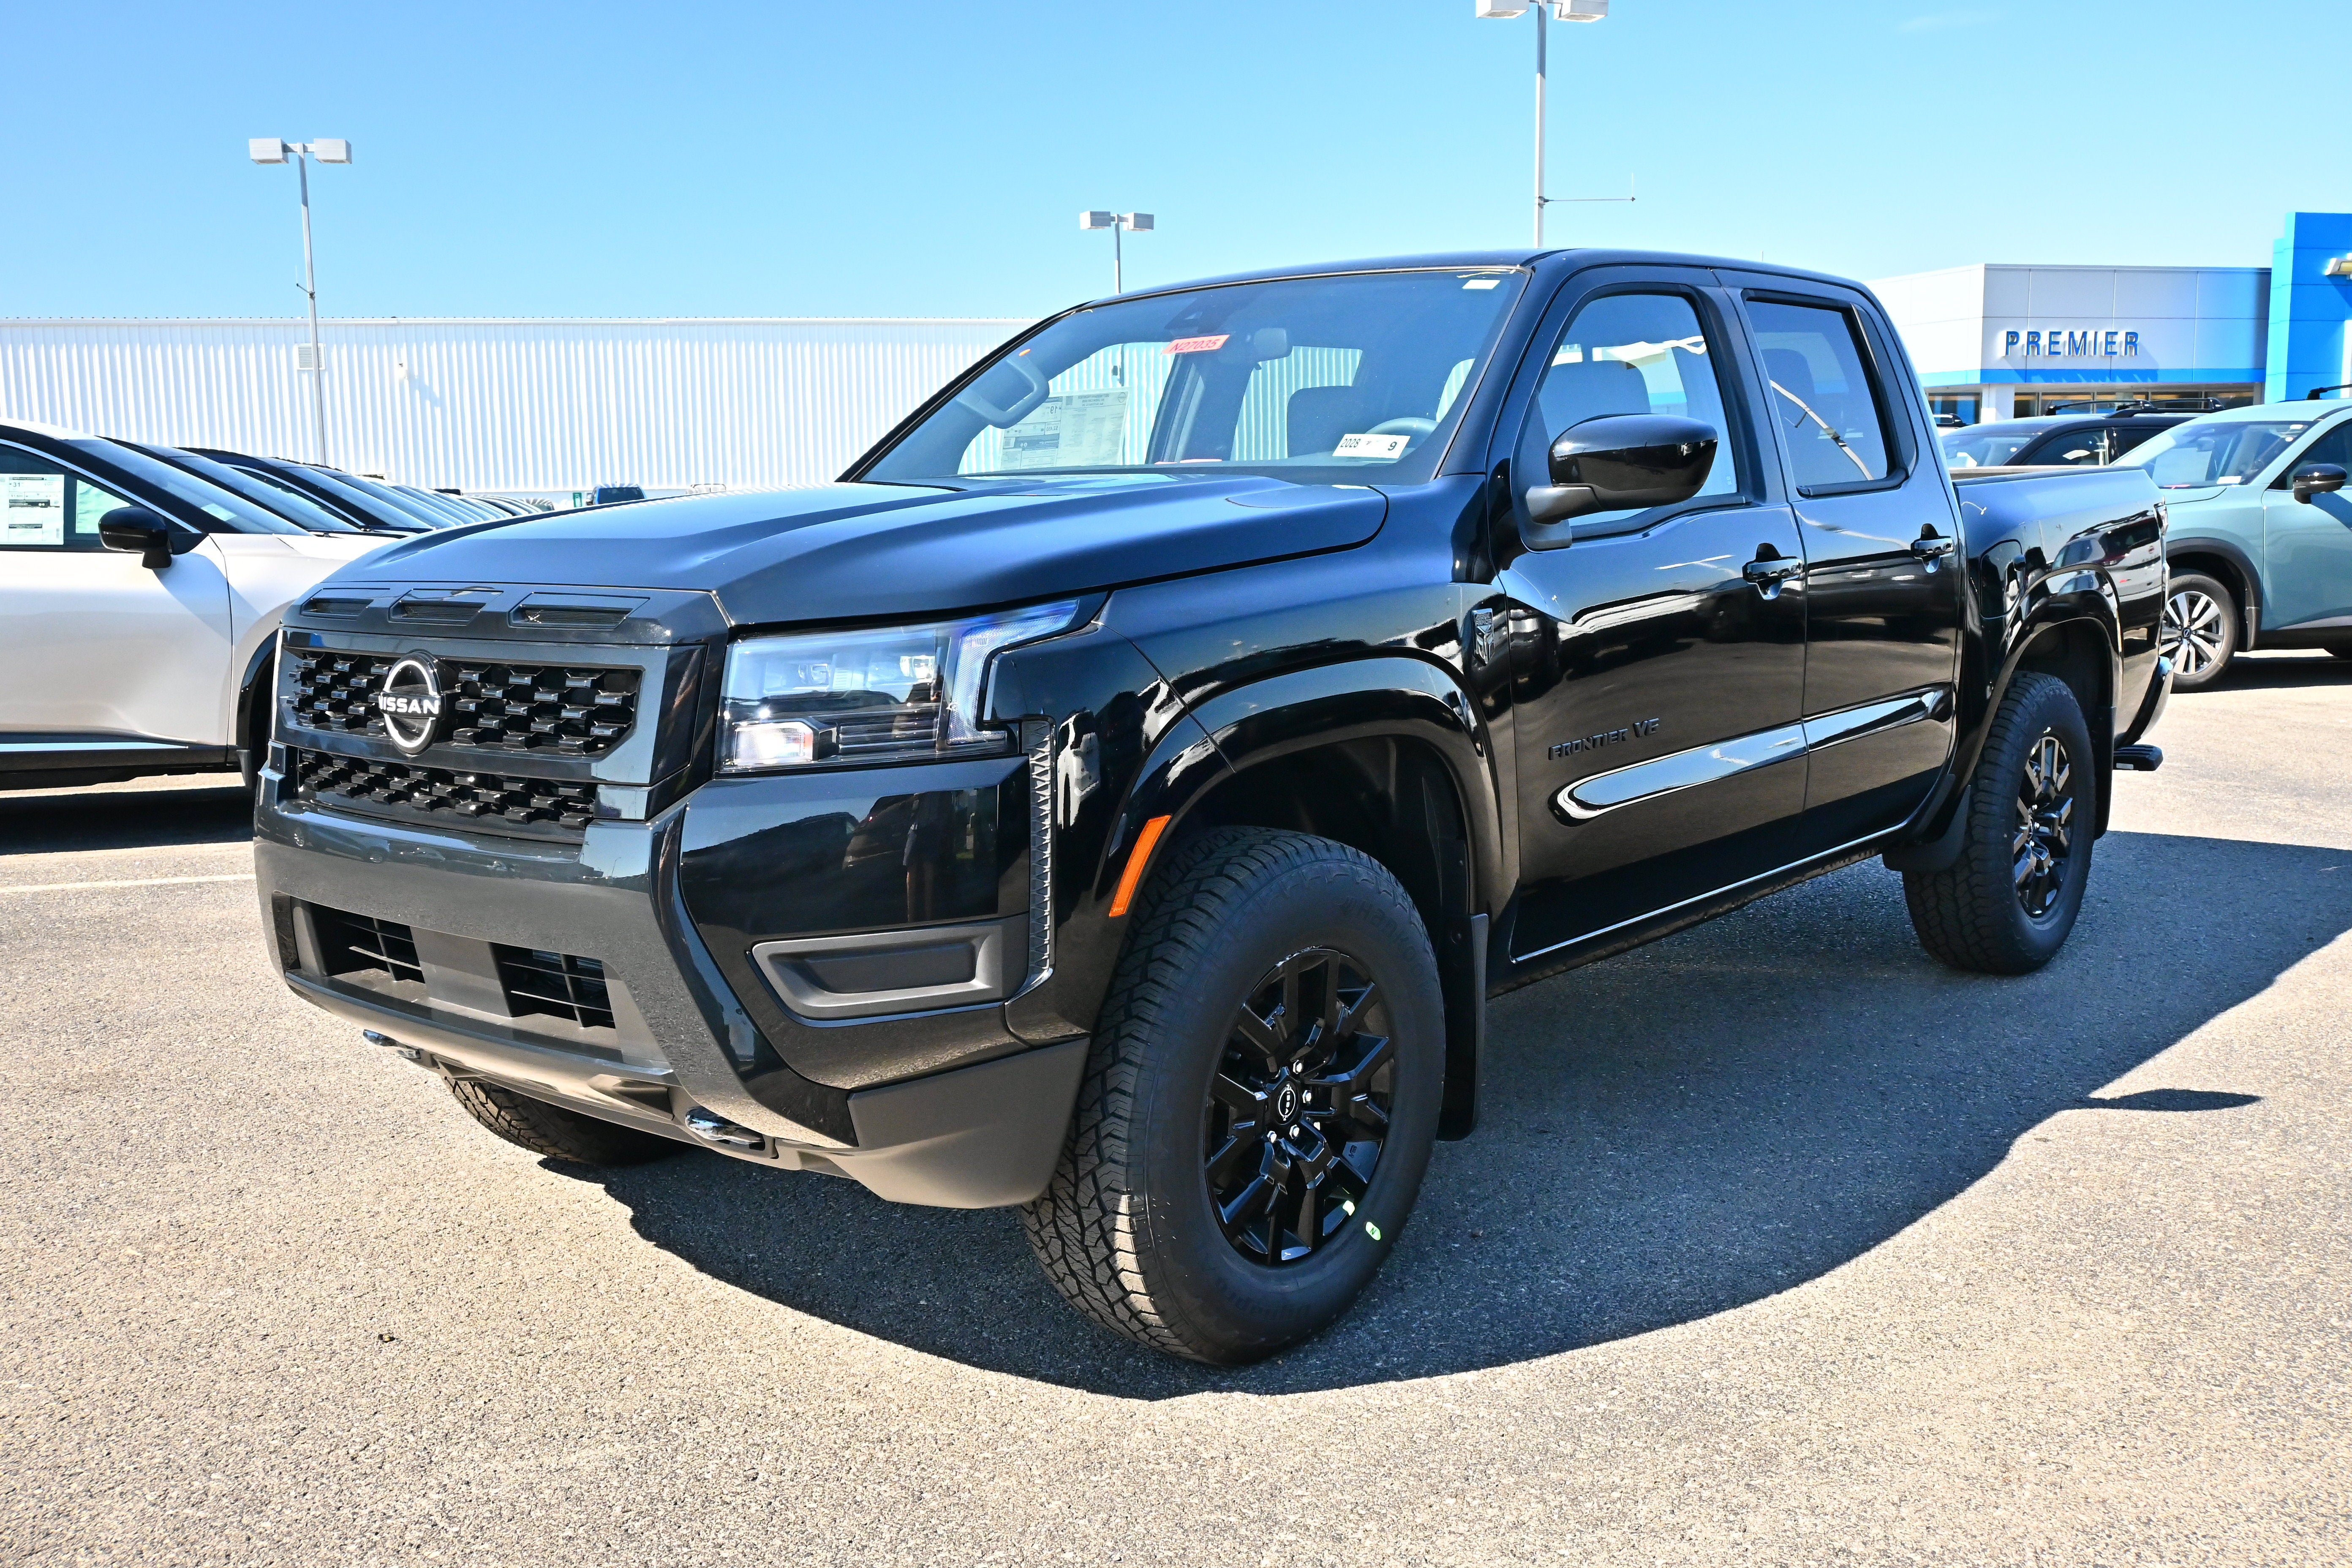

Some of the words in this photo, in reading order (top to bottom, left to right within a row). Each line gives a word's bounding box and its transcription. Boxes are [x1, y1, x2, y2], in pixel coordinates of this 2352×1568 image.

[1169, 339, 1220, 352] N27035
[2005, 331, 2139, 356] PREMIER
[1340, 438, 1361, 448] 2028
[1388, 441, 1397, 451] 9
[378, 692, 439, 715] NISSAN
[1548, 728, 1628, 760] FRONTIER
[1633, 718, 1659, 738] V6
